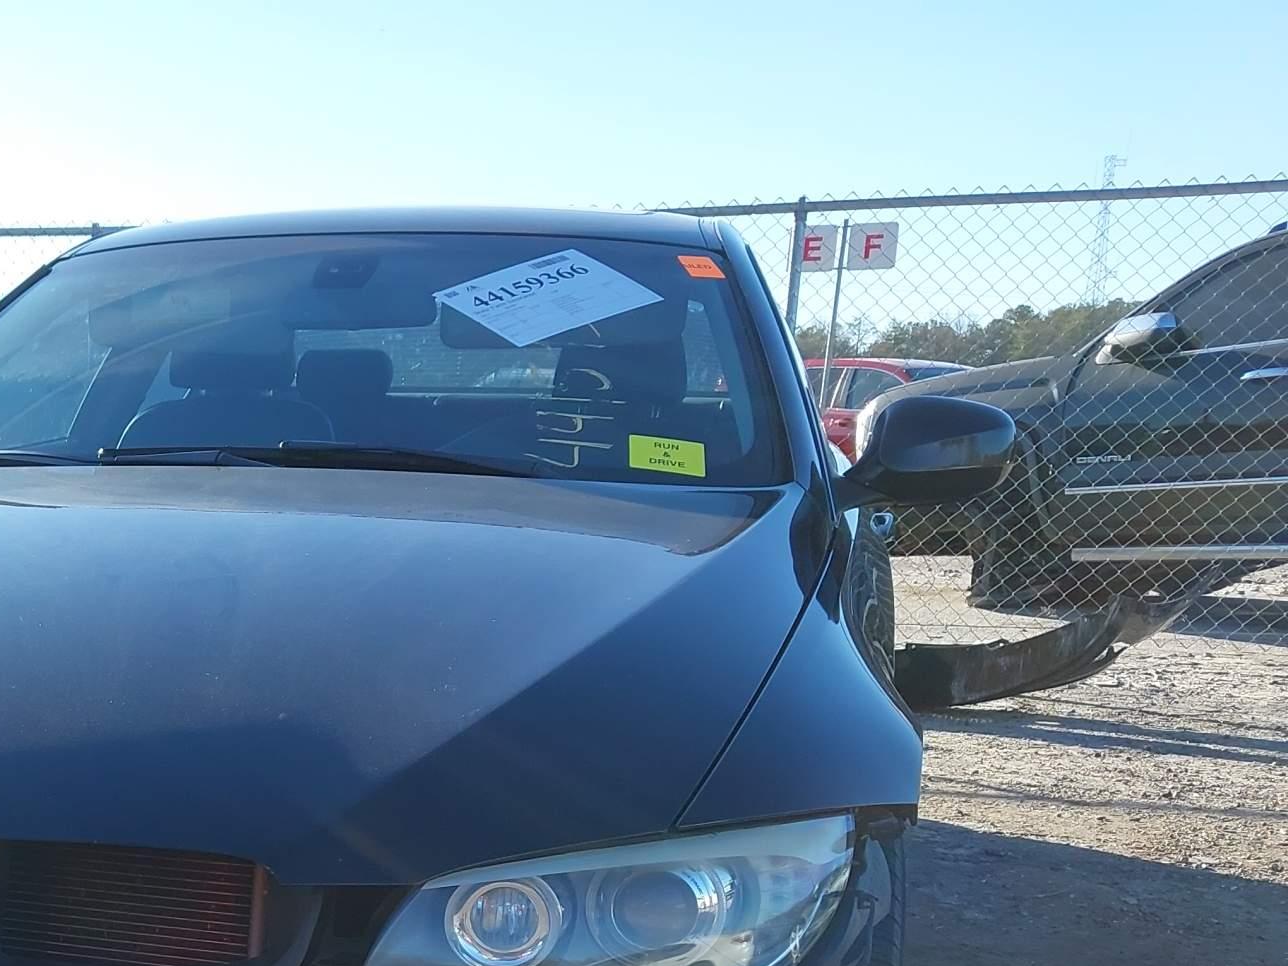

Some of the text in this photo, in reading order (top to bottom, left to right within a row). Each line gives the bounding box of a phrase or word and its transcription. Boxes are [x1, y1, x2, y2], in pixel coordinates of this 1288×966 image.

[802, 236, 823, 262] E
[863, 233, 884, 259] F
[472, 263, 590, 309] 44159366
[653, 441, 680, 451] RUN
[648, 457, 686, 468] DRIVE
[1076, 454, 1132, 464] DENALI
